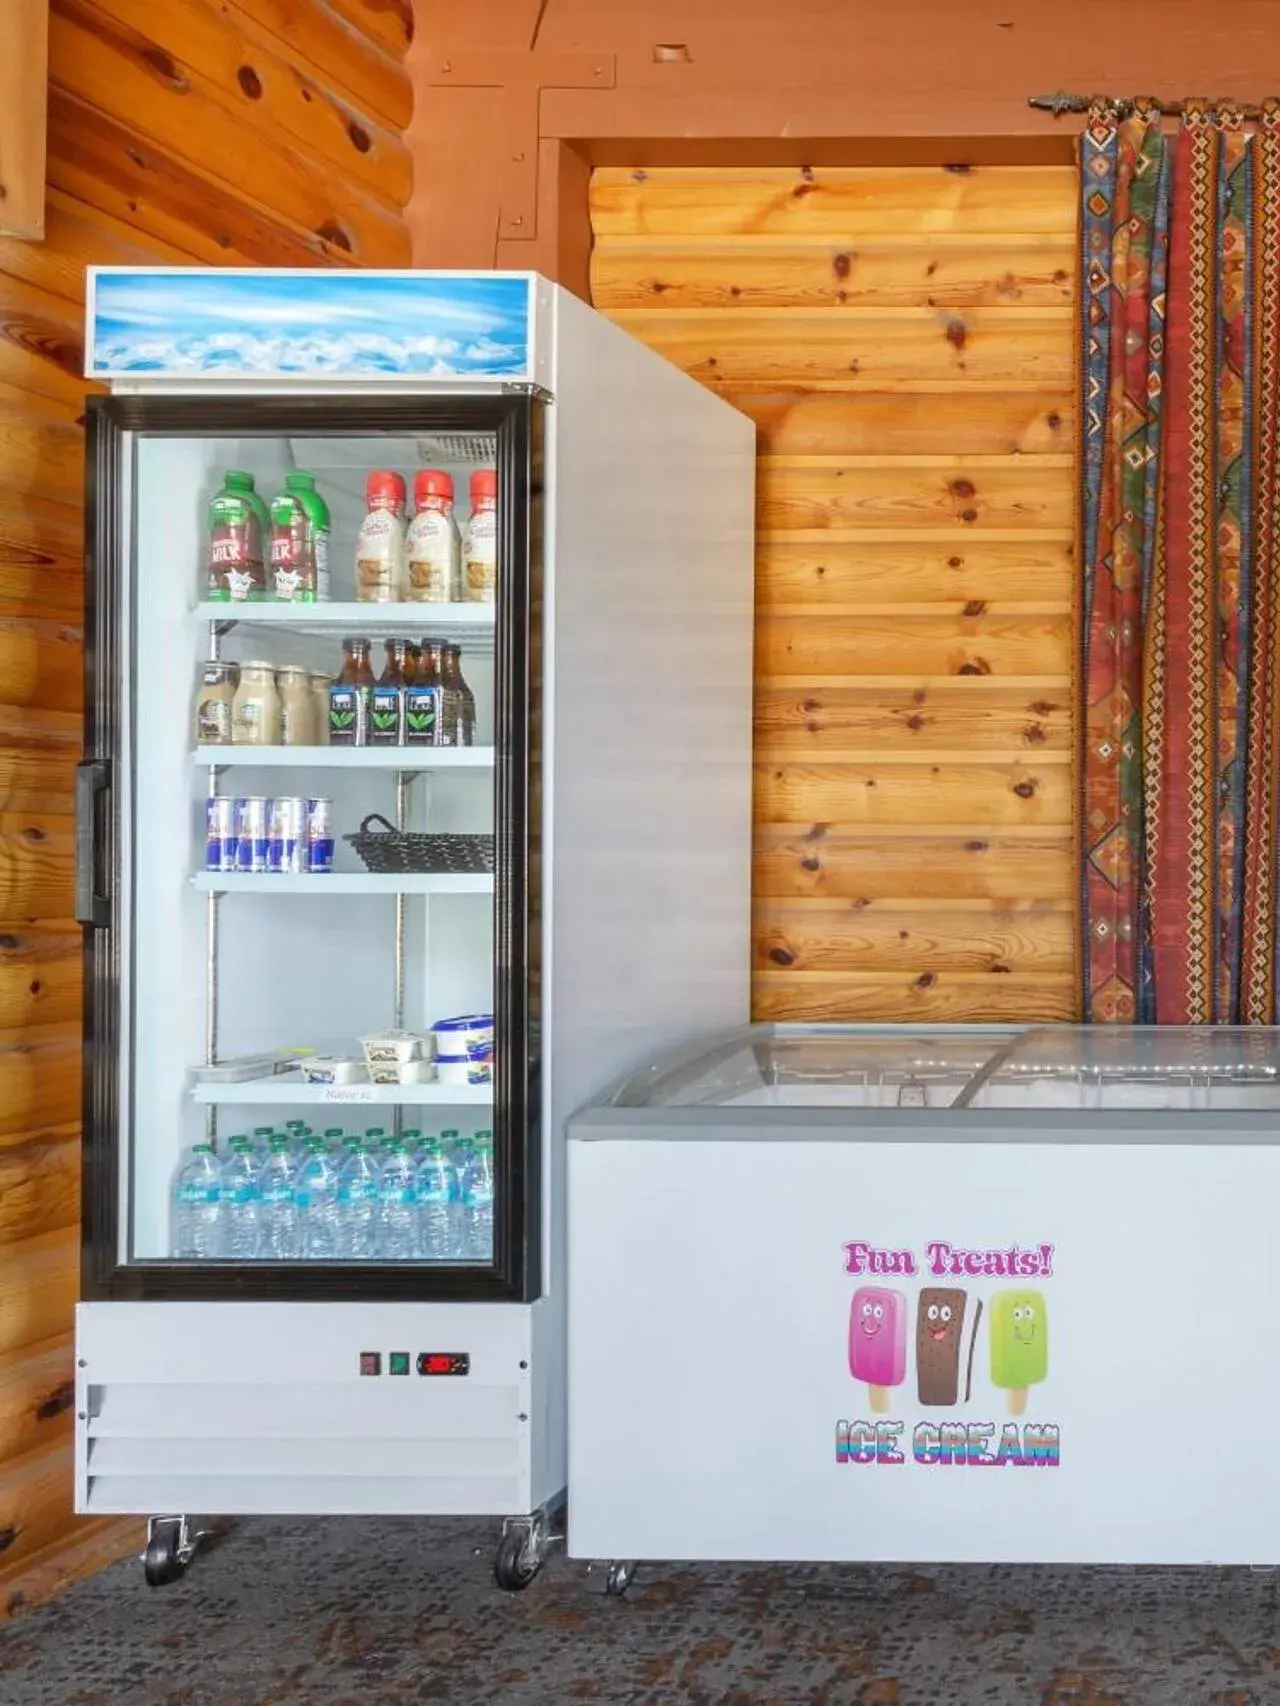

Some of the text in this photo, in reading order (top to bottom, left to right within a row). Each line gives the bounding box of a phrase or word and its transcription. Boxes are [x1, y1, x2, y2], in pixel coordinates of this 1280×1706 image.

[844, 1241, 1056, 1276] Fun Treats!
[835, 1418, 1060, 1467] ICE CREAM
